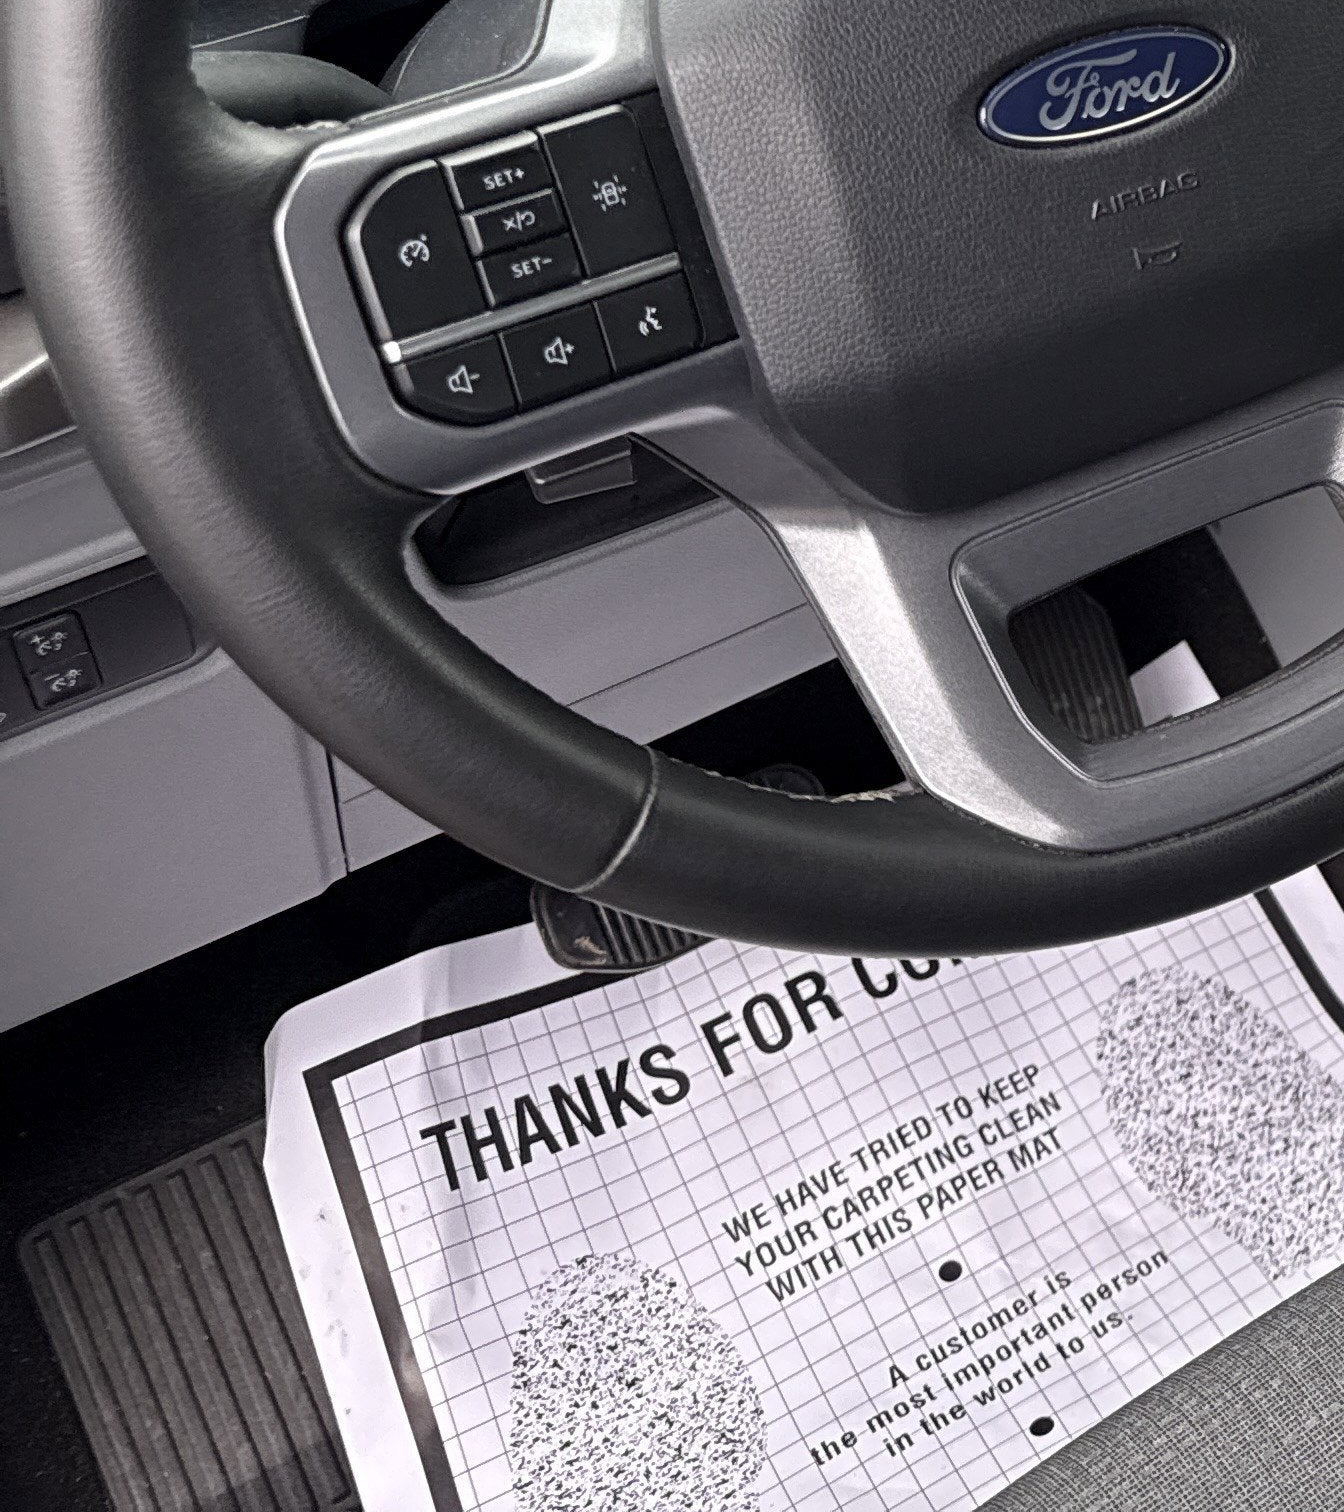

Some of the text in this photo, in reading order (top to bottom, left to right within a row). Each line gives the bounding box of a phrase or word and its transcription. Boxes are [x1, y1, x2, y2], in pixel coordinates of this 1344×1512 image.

[1039, 48, 1181, 131] Ford
[1091, 170, 1199, 221] AIRBAG
[420, 970, 844, 1192] THANKS FOR
[722, 1063, 1040, 1244] WE HAVE TRIED TO KEEP
[735, 1091, 1063, 1278] YOUR CARPETING CLEAN
[764, 1127, 1064, 1305] WITH THIS PAPER MAT
[810, 1250, 1169, 1466] the most important person
[884, 1311, 1135, 1457] in the world to us.
[887, 1270, 1072, 1388] A customer is
